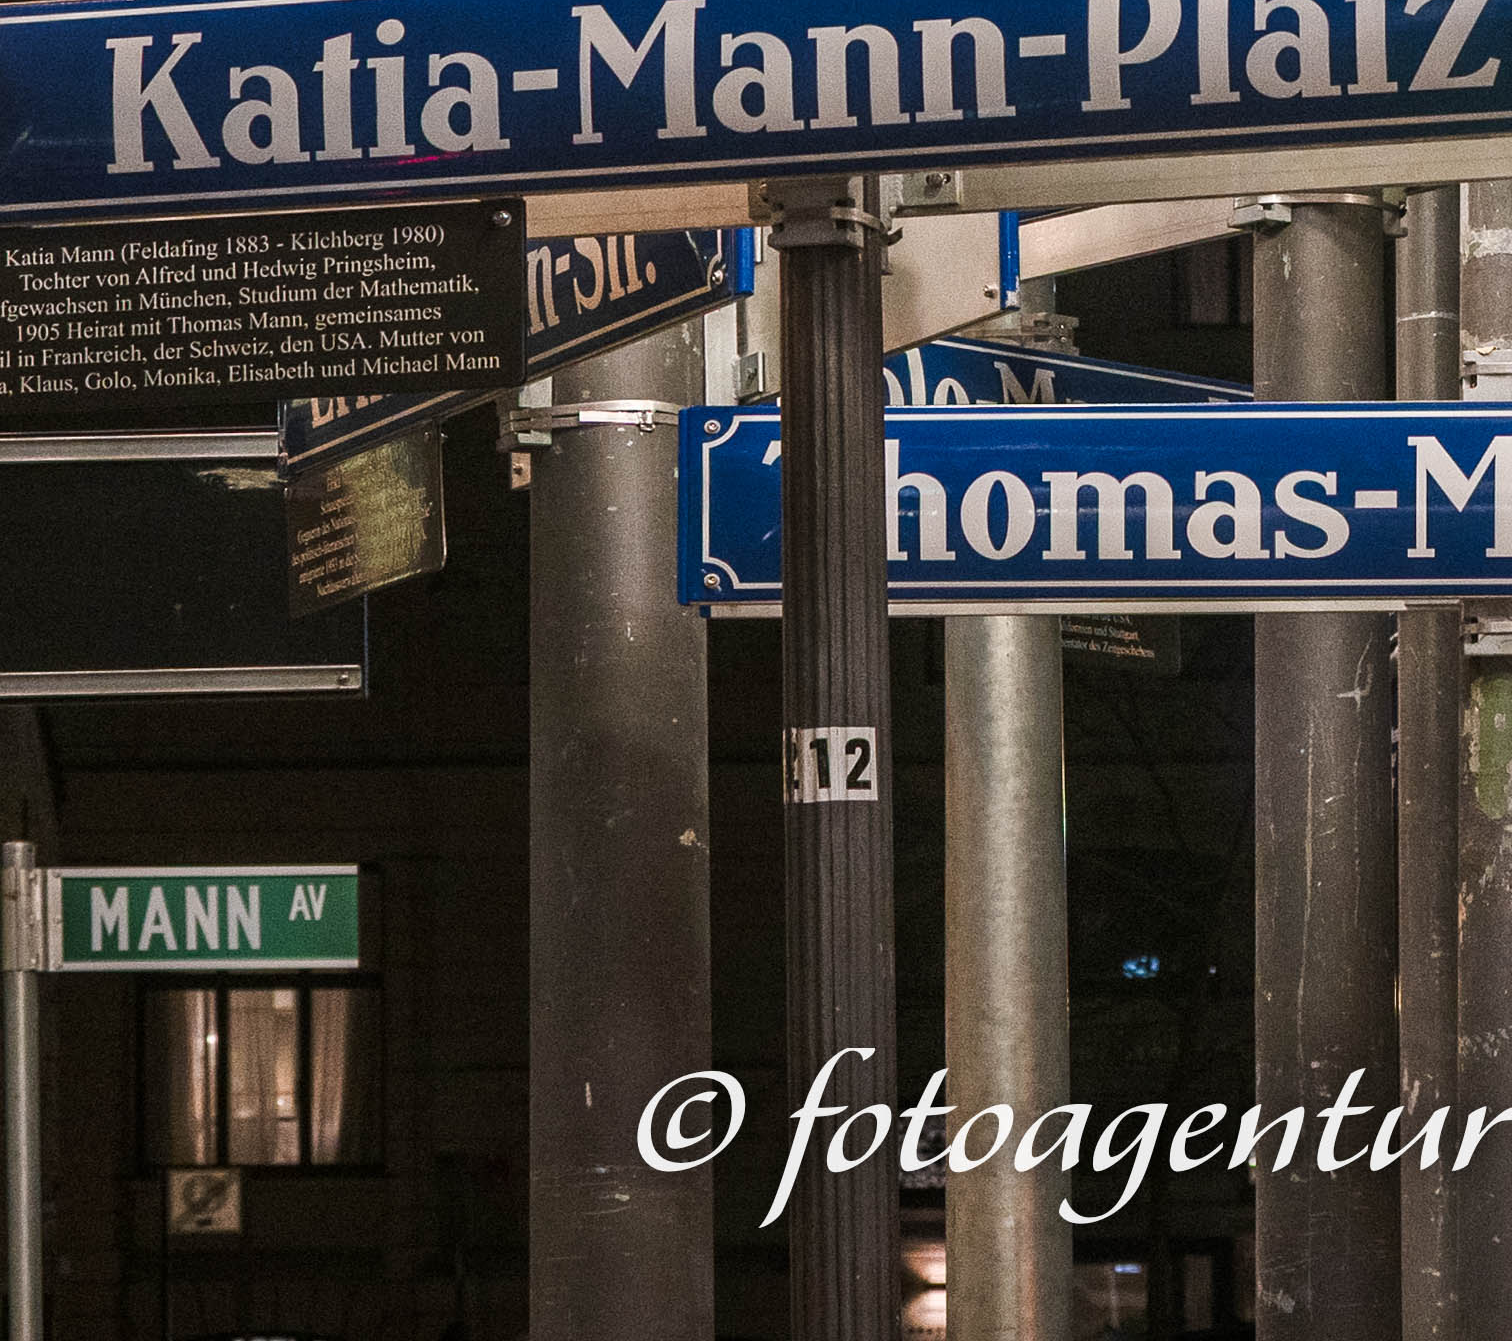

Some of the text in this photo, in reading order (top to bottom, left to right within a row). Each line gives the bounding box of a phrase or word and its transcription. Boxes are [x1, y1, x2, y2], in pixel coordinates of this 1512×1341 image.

[6, 247, 54, 267] Katia
[61, 246, 115, 264] Mann
[121, 239, 218, 264] (Feldafing
[227, 235, 269, 254] 1883
[292, 230, 384, 251] Kilchberg
[393, 226, 444, 245] 1980)
[19, 251, 435, 291] Tochter von Alfred und Hedwig Pringsheim,
[116, 294, 132, 311] in
[140, 290, 232, 310] München,
[239, 285, 317, 304] Studium
[323, 282, 354, 300] der
[360, 274, 479, 298] Mathematik,
[18, 305, 441, 342] 1905 Heirat mit Thomas Mann, gemeinsames
[18, 350, 34, 367] in
[42, 344, 147, 366] Frankreich,
[153, 343, 184, 360] der
[190, 337, 274, 358] Schweiz,
[280, 335, 313, 353] den
[321, 333, 372, 351] USA.
[380, 330, 444, 348] Mutter
[450, 330, 484, 343] von
[21, 375, 78, 393] Klaus,
[85, 371, 137, 389] Golo,
[144, 367, 221, 387] Monika,
[229, 361, 314, 382] Elisabeth
[321, 359, 355, 377] und
[363, 354, 438, 375] Michael
[446, 353, 500, 370] Mann
[92, 884, 327, 951] MANN AV
